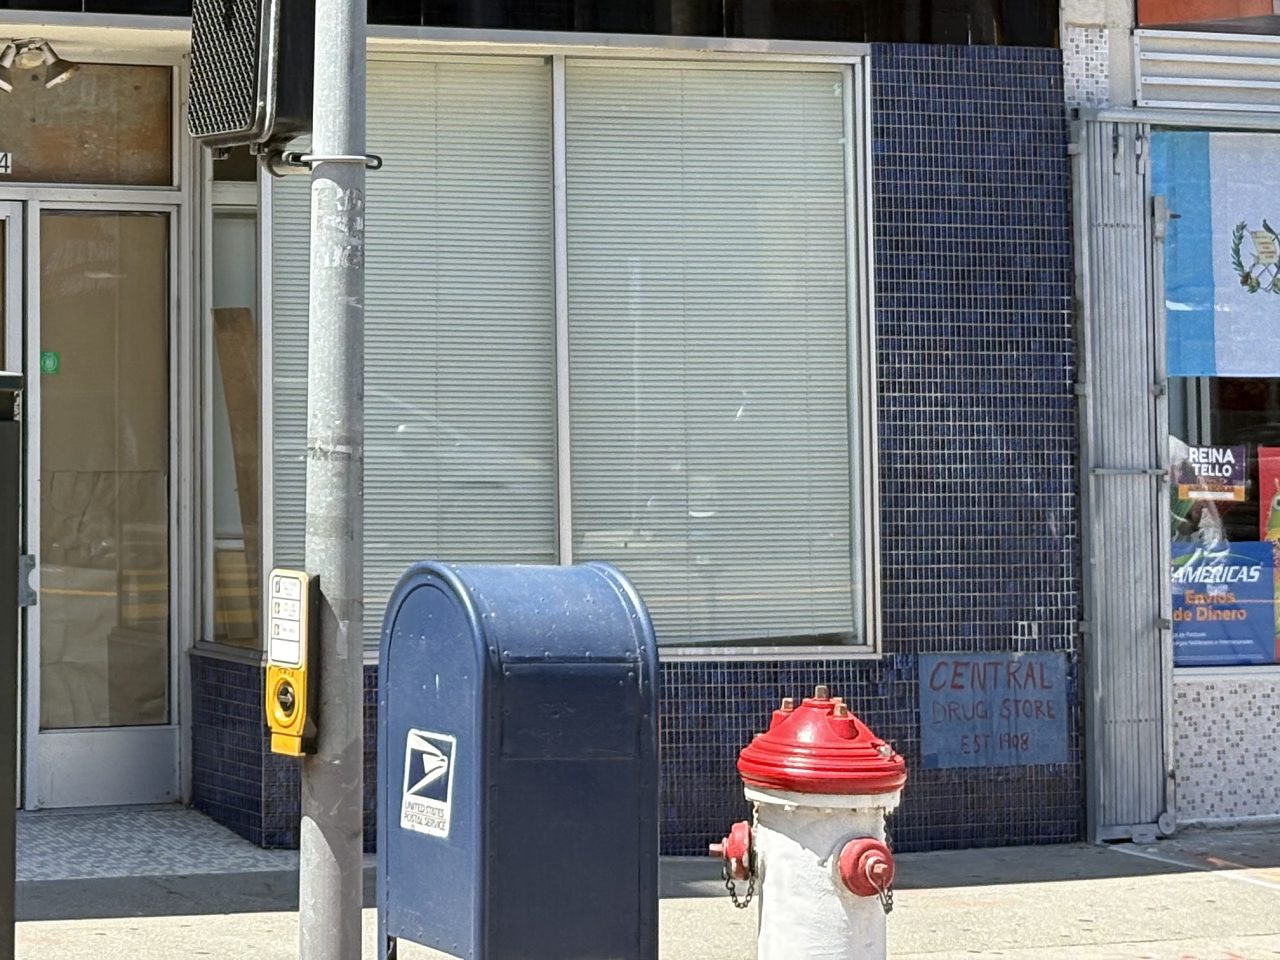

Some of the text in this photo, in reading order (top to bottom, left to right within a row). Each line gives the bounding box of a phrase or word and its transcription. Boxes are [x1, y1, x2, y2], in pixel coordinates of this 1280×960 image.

[1189, 447, 1235, 464] REINA
[1192, 463, 1232, 477] TELLO
[1171, 565, 1262, 583] AMERICAS
[1173, 605, 1248, 622] de Dinero
[929, 660, 1053, 691] CENTRAL
[932, 698, 1056, 724] DRUG STORE
[960, 734, 991, 754] EST
